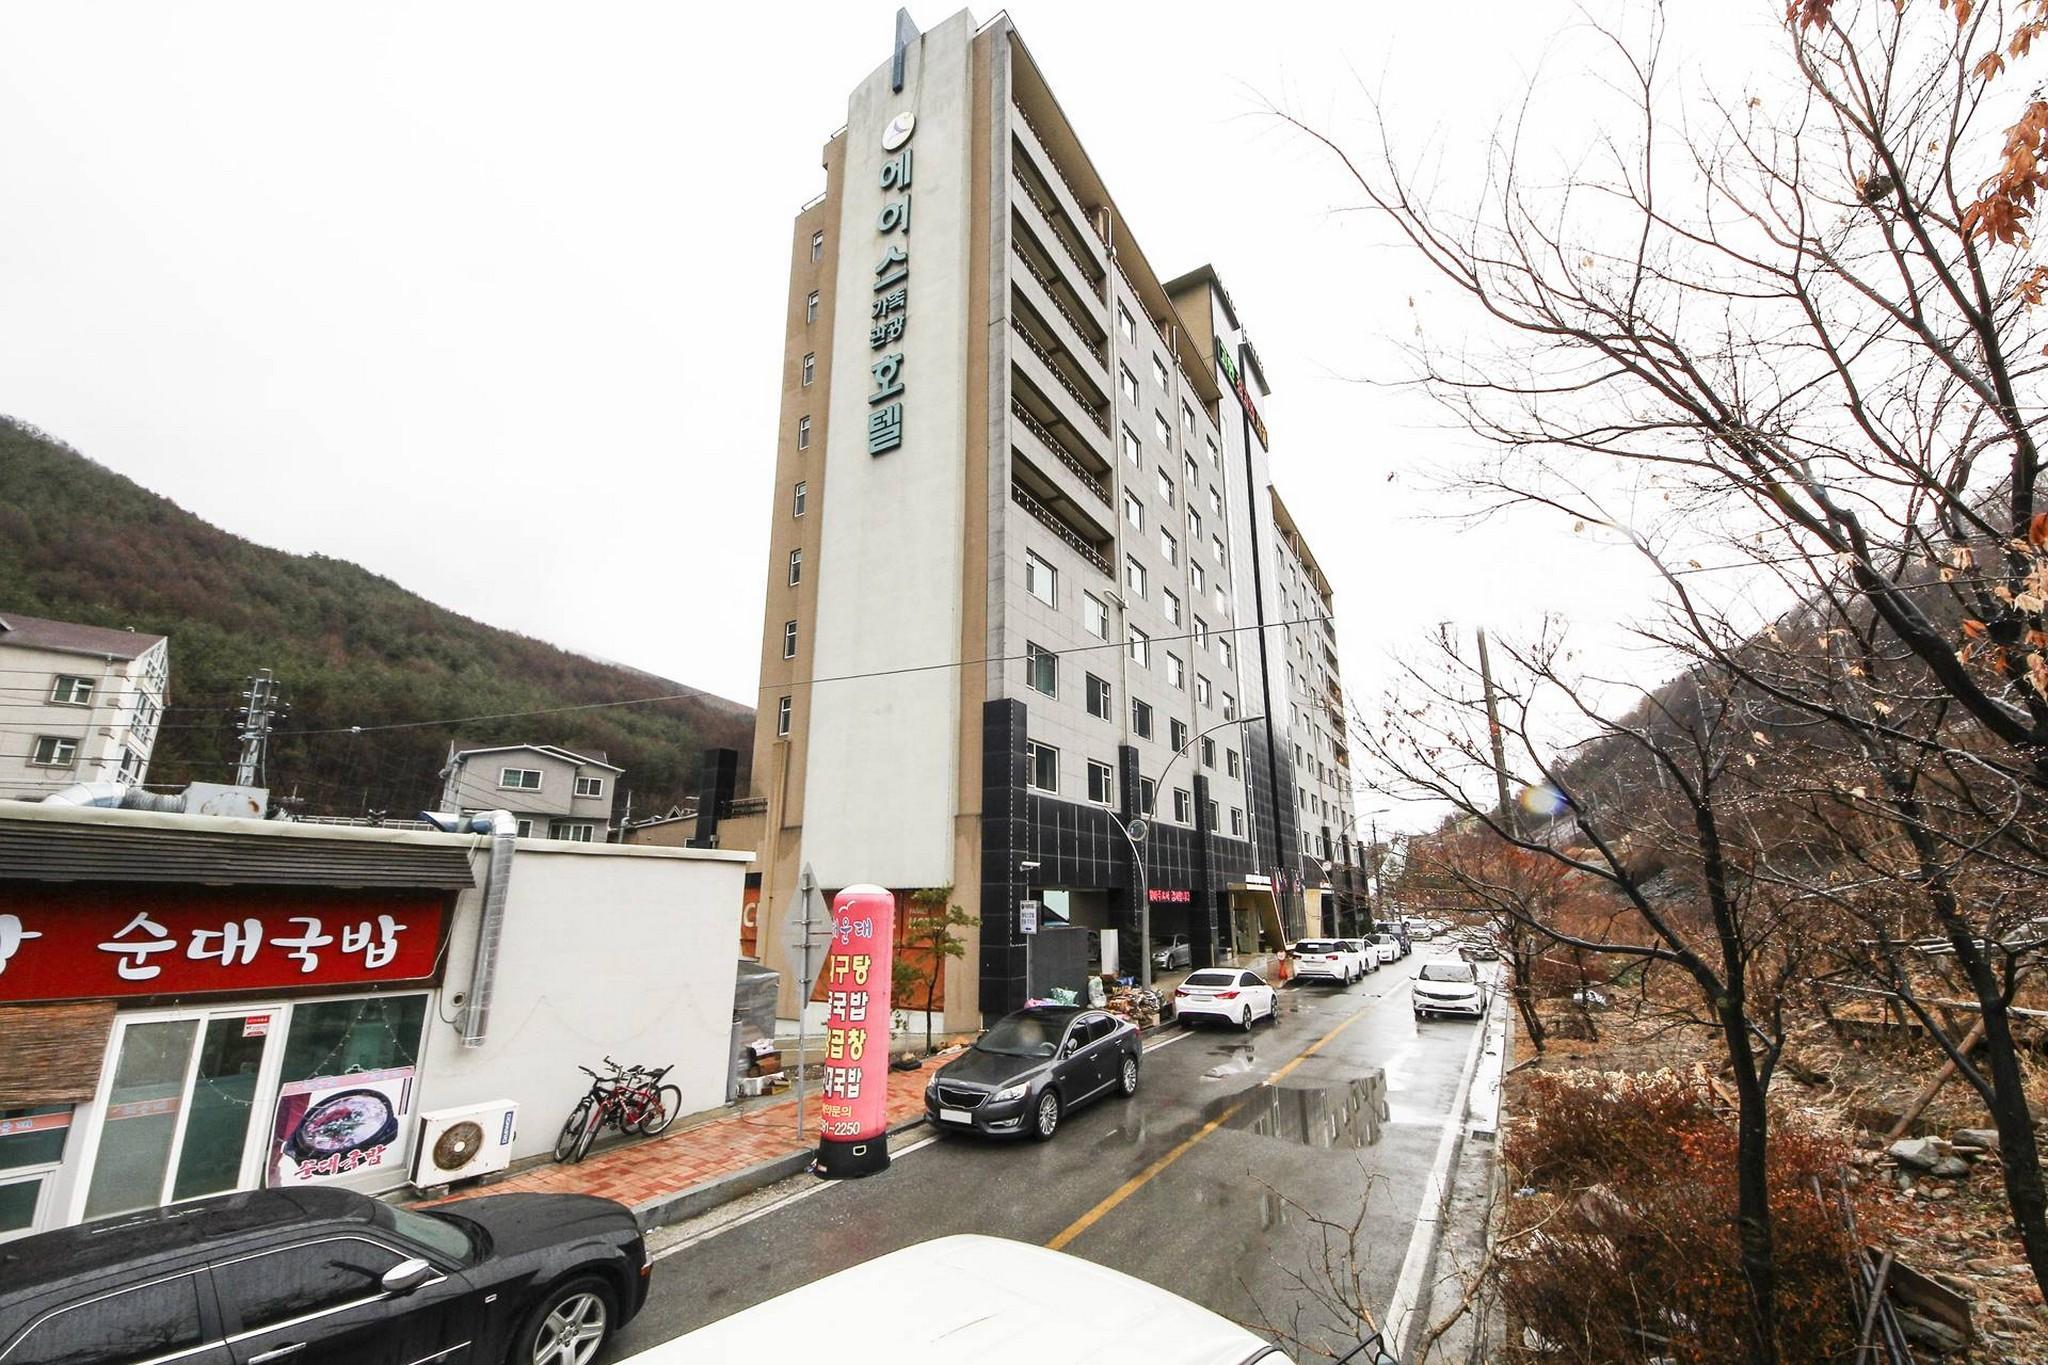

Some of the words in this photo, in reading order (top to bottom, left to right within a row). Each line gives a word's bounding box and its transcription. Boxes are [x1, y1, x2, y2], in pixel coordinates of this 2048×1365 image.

[874, 149, 913, 292] 에이스
[868, 353, 904, 456] 호텔
[97, 911, 408, 981] 순대국밥
[829, 954, 872, 986] 구탕
[827, 990, 869, 1022] 국밥
[825, 1027, 867, 1060] 곱창
[294, 1143, 388, 1180] 순대국밥
